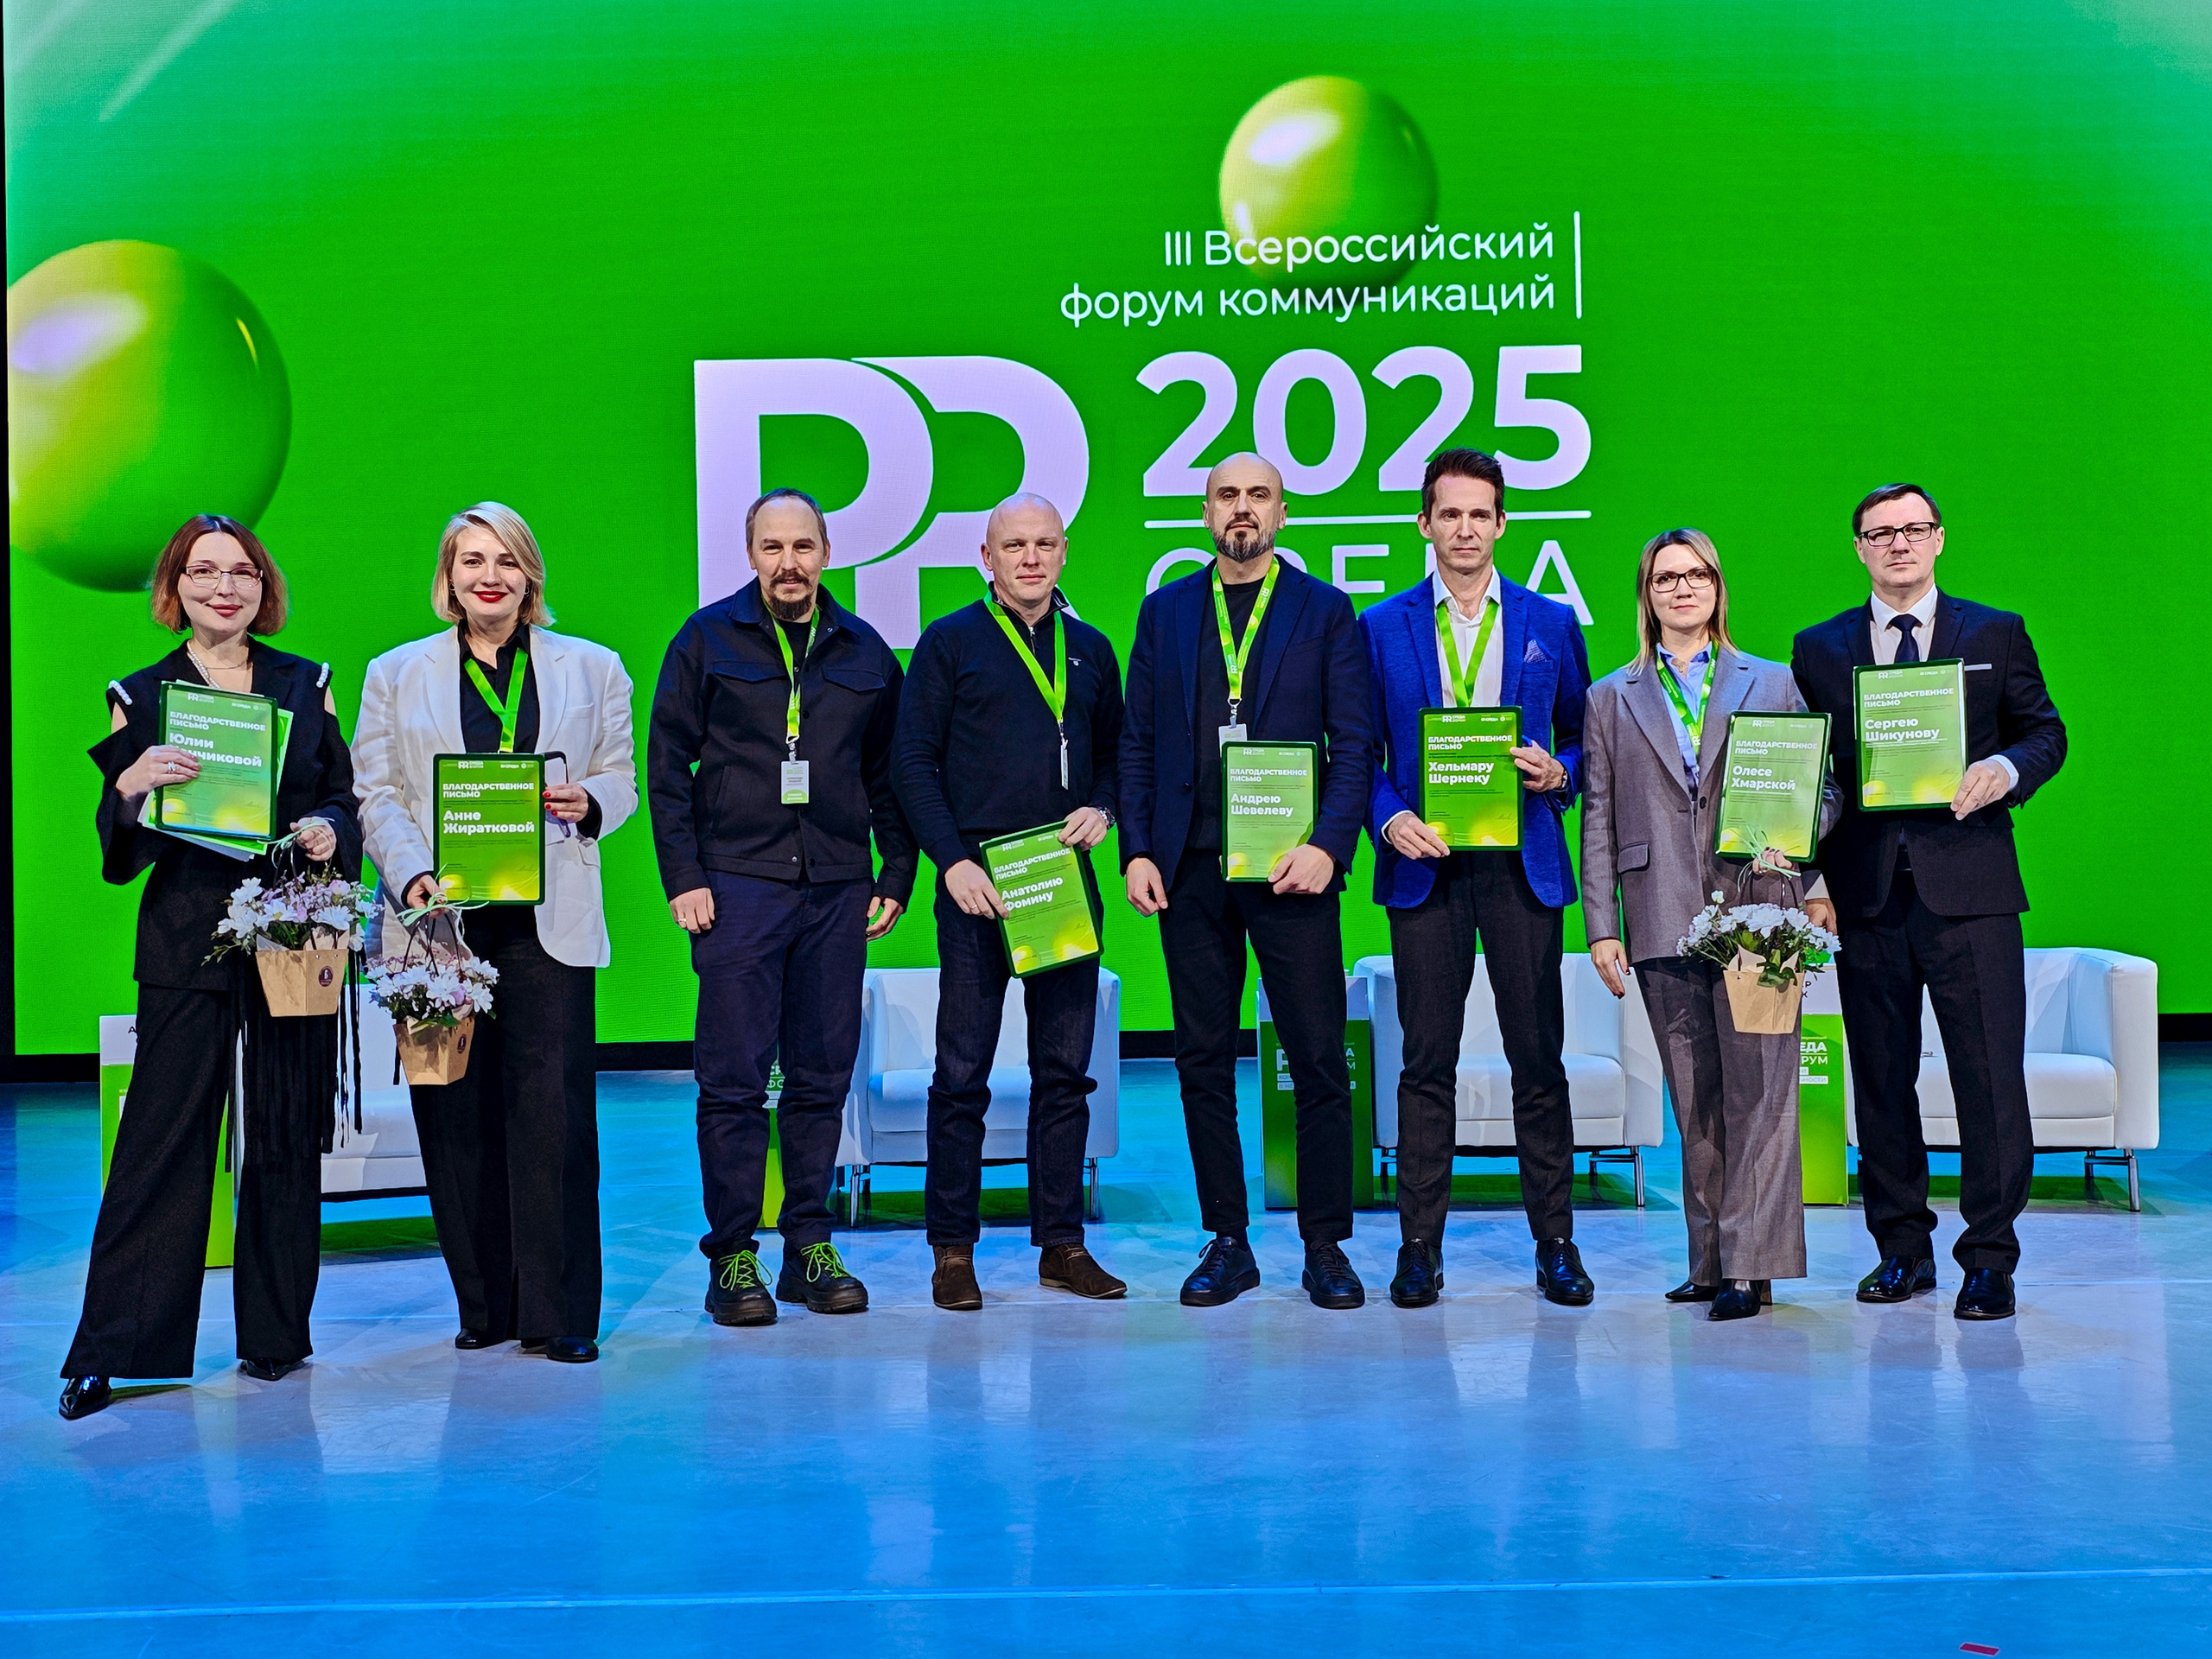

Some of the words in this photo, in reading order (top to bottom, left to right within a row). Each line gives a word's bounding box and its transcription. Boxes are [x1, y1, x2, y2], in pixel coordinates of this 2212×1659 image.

[1164, 231, 1192, 266] III
[1204, 222, 1554, 272] Всероссийский
[1060, 283, 1203, 327] форум
[1220, 273, 1554, 322] коммуникаций
[1136, 344, 1592, 497] 2025
[694, 355, 1090, 649] PR
[1864, 688, 1954, 701] БЛАГОДАРСТВЕННОЕ
[1864, 699, 1901, 708] ПИСЬМО
[169, 711, 266, 732] БЛАГОДАРСТВЕННОЕ
[169, 719, 209, 730] ПИСЬМО
[1865, 718, 1919, 730] Сергею
[169, 733, 214, 749] Юлии
[1865, 728, 1940, 742] Шикунову
[1736, 741, 1817, 750] БЛАГОДАРСТВЕННОЕ
[1428, 762, 1494, 772] Хельмару
[1732, 766, 1772, 777] Олесе
[1428, 773, 1490, 785] Шернеку
[1731, 778, 1796, 791] Хмарской
[1230, 793, 1281, 805] Андрею
[443, 810, 481, 821] Анне
[1230, 805, 1294, 817] Шевелеву
[443, 822, 535, 836] Жиратковой
[994, 848, 1071, 874] БЛАГОДАРСТВЕННОЕ
[995, 867, 1027, 880] ПИСЬМО
[1001, 877, 1063, 900] Анатолию
[1004, 891, 1053, 912] Фомину
[1800, 1042, 1827, 1052] ЕДА
[1802, 1056, 1828, 1065] РУМ
